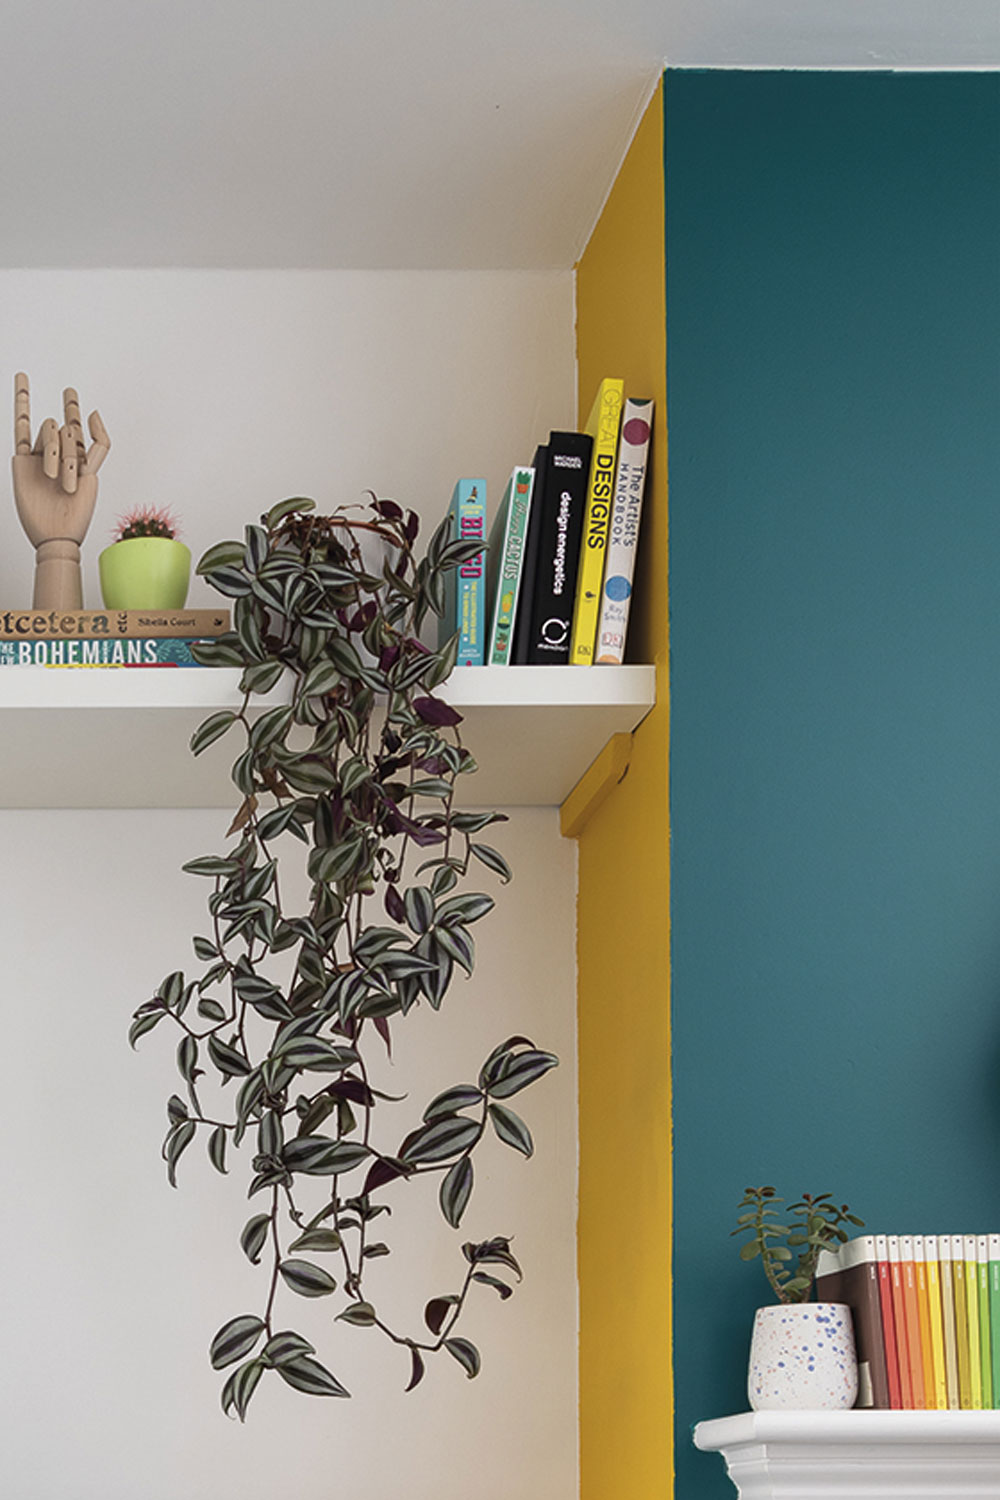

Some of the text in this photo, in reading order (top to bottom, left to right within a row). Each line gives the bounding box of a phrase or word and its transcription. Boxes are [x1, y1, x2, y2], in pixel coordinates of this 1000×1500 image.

[588, 388, 621, 550] GREAT DESIGNS
[630, 466, 645, 491] The
[611, 463, 629, 546] HANDBOOK
[460, 516, 483, 579] BIGO
[504, 535, 522, 581] CACTUS
[169, 617, 196, 627] Court
[18, 640, 158, 665] BOHEMIANS
